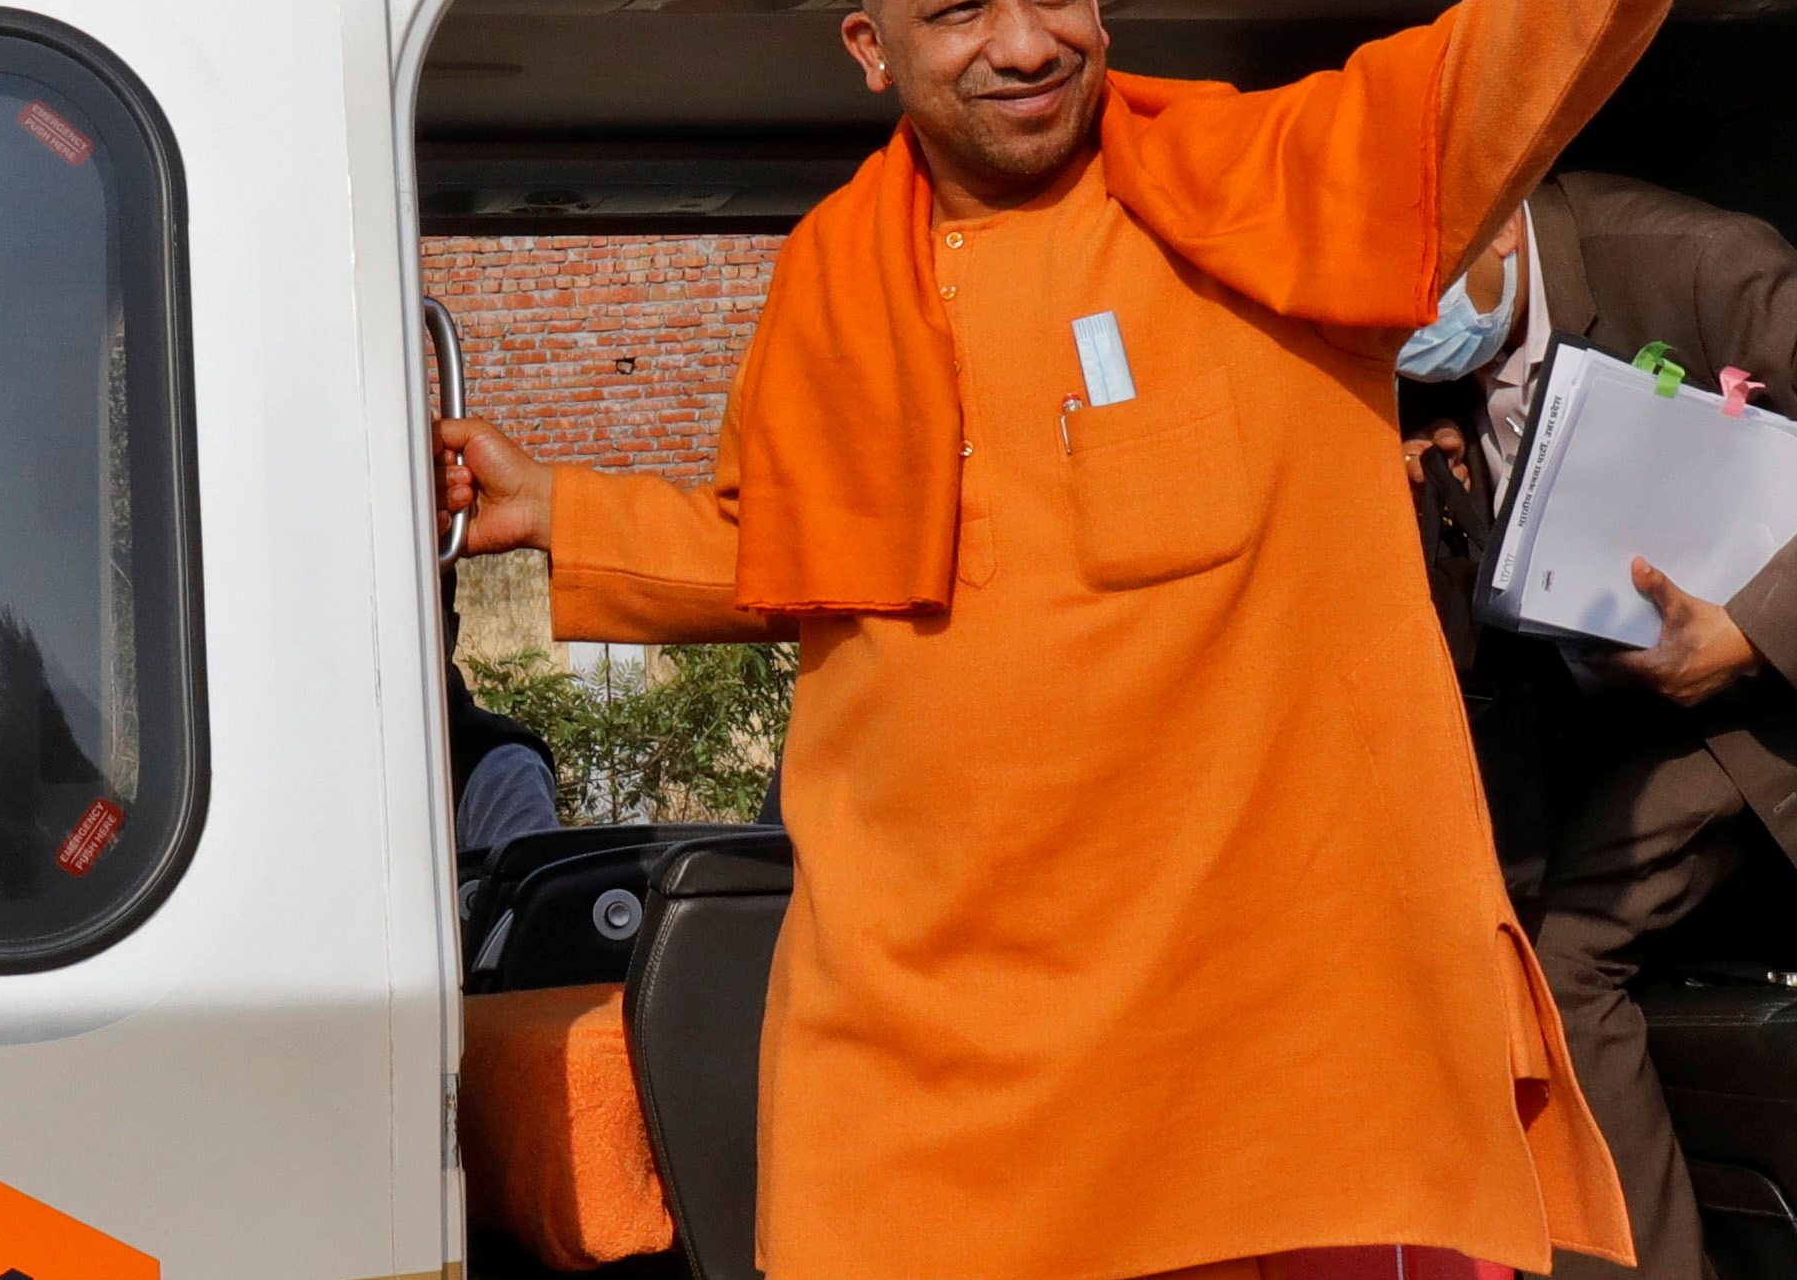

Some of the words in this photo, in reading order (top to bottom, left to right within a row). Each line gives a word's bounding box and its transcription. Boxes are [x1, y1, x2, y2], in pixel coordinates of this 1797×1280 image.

[24, 117, 51, 141] PUSH
[31, 104, 89, 150] EMERGENCY
[60, 801, 104, 863] EMERGENCY
[75, 841, 99, 870] PUSH
[93, 814, 117, 843] HERE
